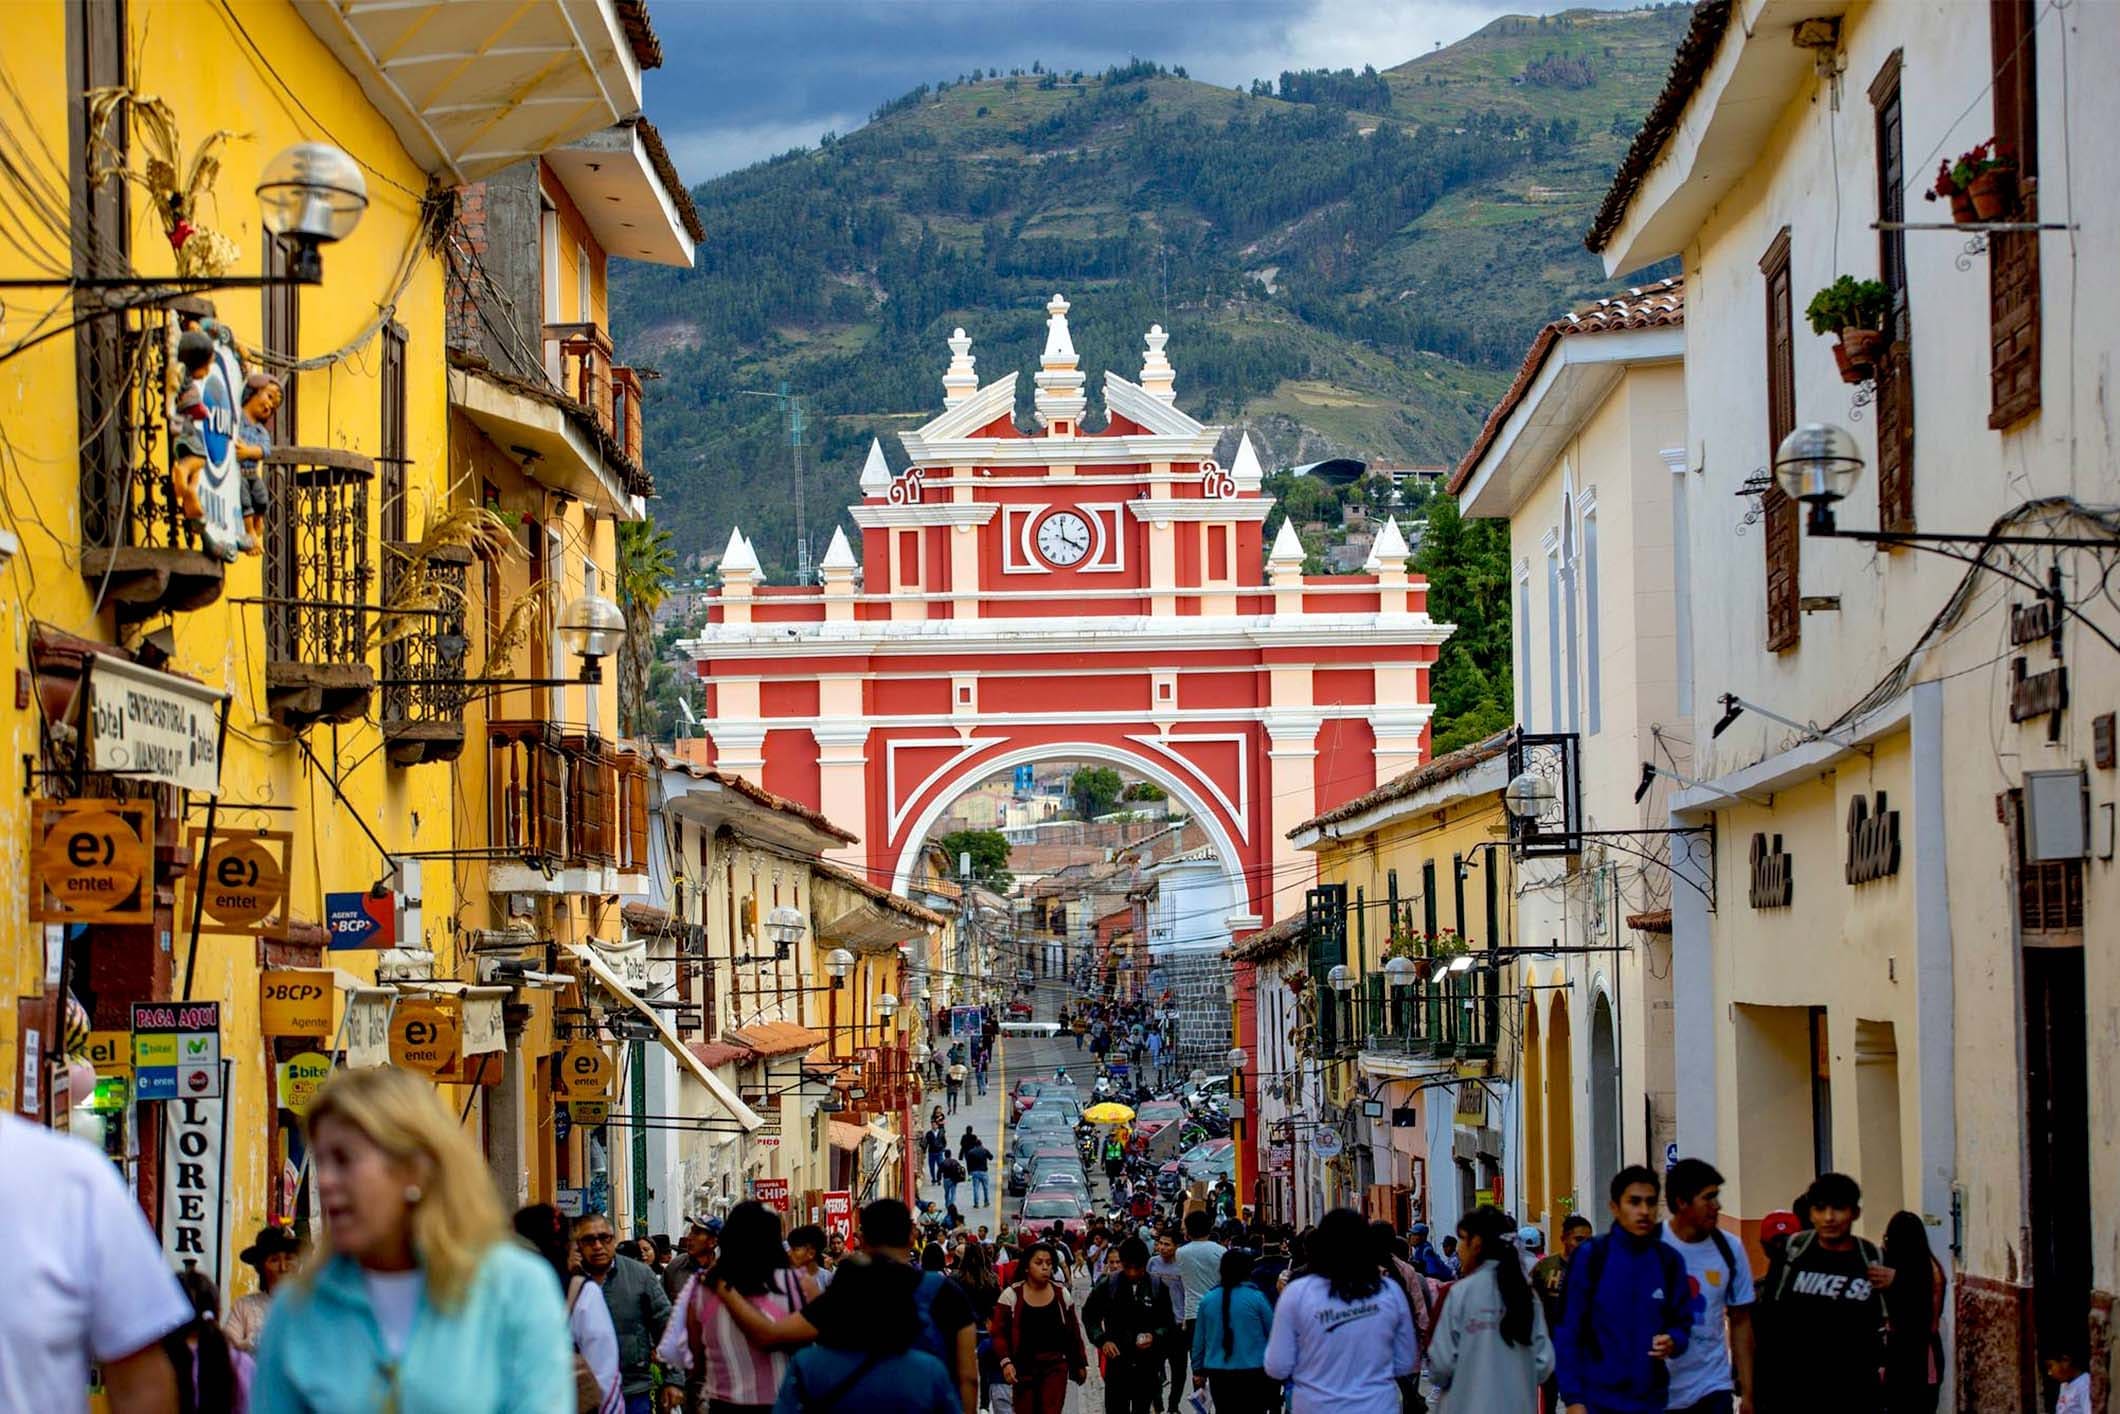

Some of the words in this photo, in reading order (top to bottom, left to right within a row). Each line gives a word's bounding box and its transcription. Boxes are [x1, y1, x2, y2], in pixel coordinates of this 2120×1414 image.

[67, 876, 115, 891] entel
[216, 896, 257, 909] entel
[332, 911, 358, 919] AGENTE
[338, 920, 366, 932] BCP
[276, 984, 313, 1000] BCP
[136, 1008, 177, 1029] PAGA
[178, 1003, 217, 1030] AQUÍ
[291, 1017, 328, 1029] Agente
[405, 1051, 438, 1061] entel
[300, 1066, 329, 1078] bite
[574, 1078, 599, 1086] entel
[756, 1187, 788, 1200] CHIP
[1792, 1270, 1849, 1297] NIKE
